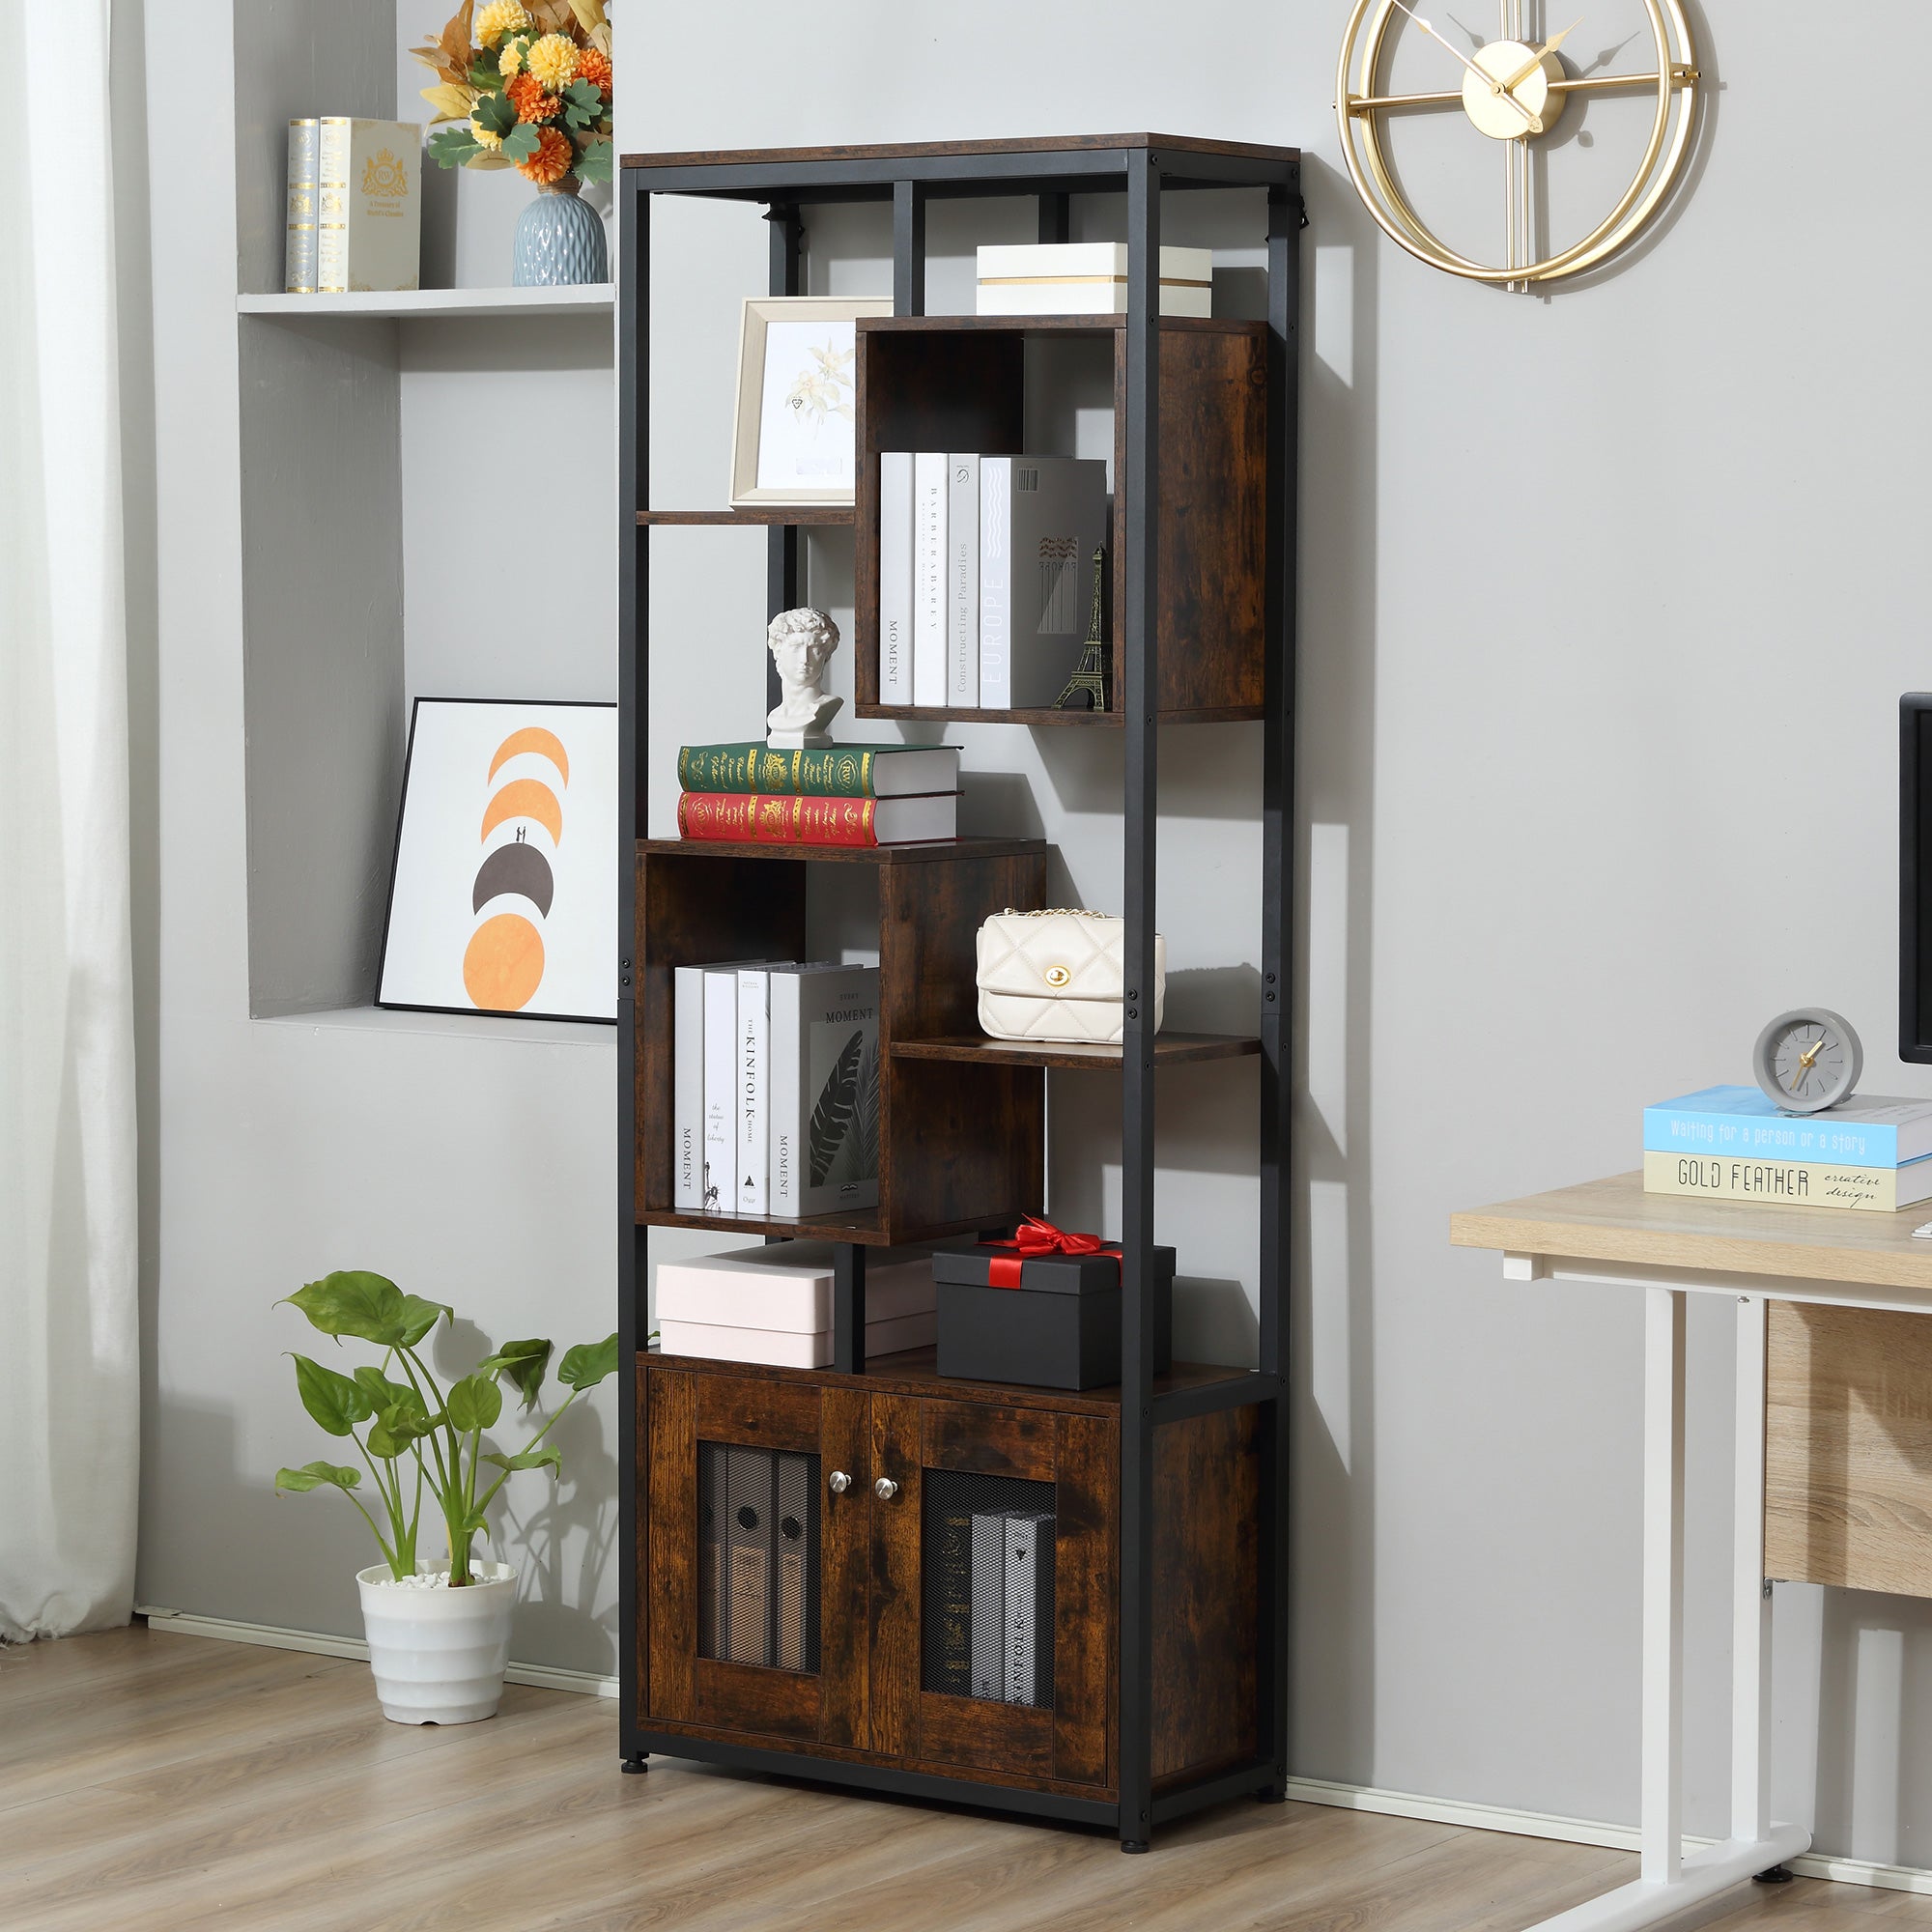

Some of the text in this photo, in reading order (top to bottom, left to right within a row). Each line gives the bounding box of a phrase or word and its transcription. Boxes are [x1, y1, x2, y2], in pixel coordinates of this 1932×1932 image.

[889, 619, 898, 686] MOMENT
[957, 607, 968, 694] Constructing
[983, 580, 1004, 684] EUROPE
[826, 1008, 874, 1024] MOMENT
[746, 1036, 755, 1120] KINFOLK
[682, 1128, 692, 1190] MOMENT
[780, 1135, 788, 1198] MOMENT
[1670, 1120, 1866, 1155] Waiting for a person or a story
[1678, 1158, 1809, 1197] GOLD FEATHER
[1824, 1174, 1881, 1186] creative
[1825, 1186, 1878, 1208] design
